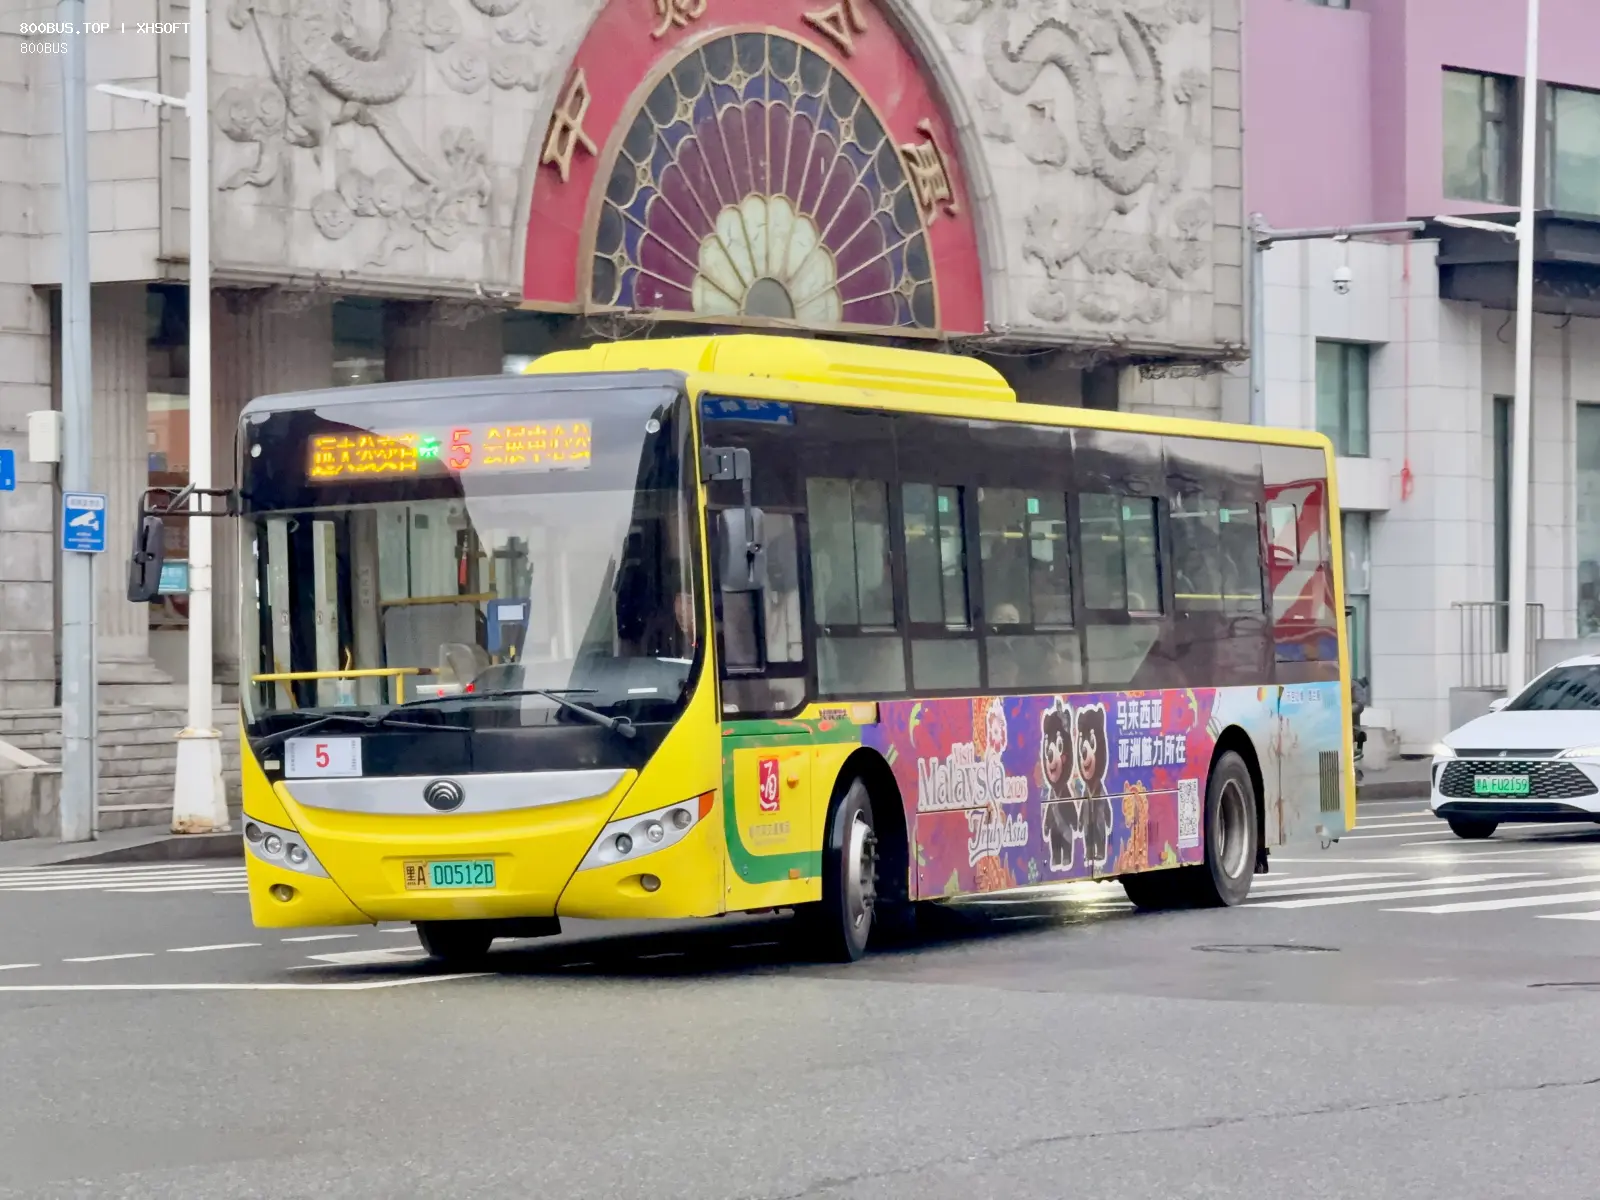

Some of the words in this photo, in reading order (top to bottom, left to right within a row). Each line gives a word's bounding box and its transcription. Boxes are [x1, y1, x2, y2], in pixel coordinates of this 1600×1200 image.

[450, 427, 472, 469] 5
[1116, 699, 1163, 730] 马来西亚
[315, 743, 331, 769] 5
[1117, 734, 1187, 768] 亚洲魅力所在
[918, 756, 1006, 806] Malaysia
[1491, 778, 1528, 791] FU2159
[967, 810, 1003, 852] Truly
[1003, 816, 1028, 843] Asia
[433, 863, 494, 886] 00512D
